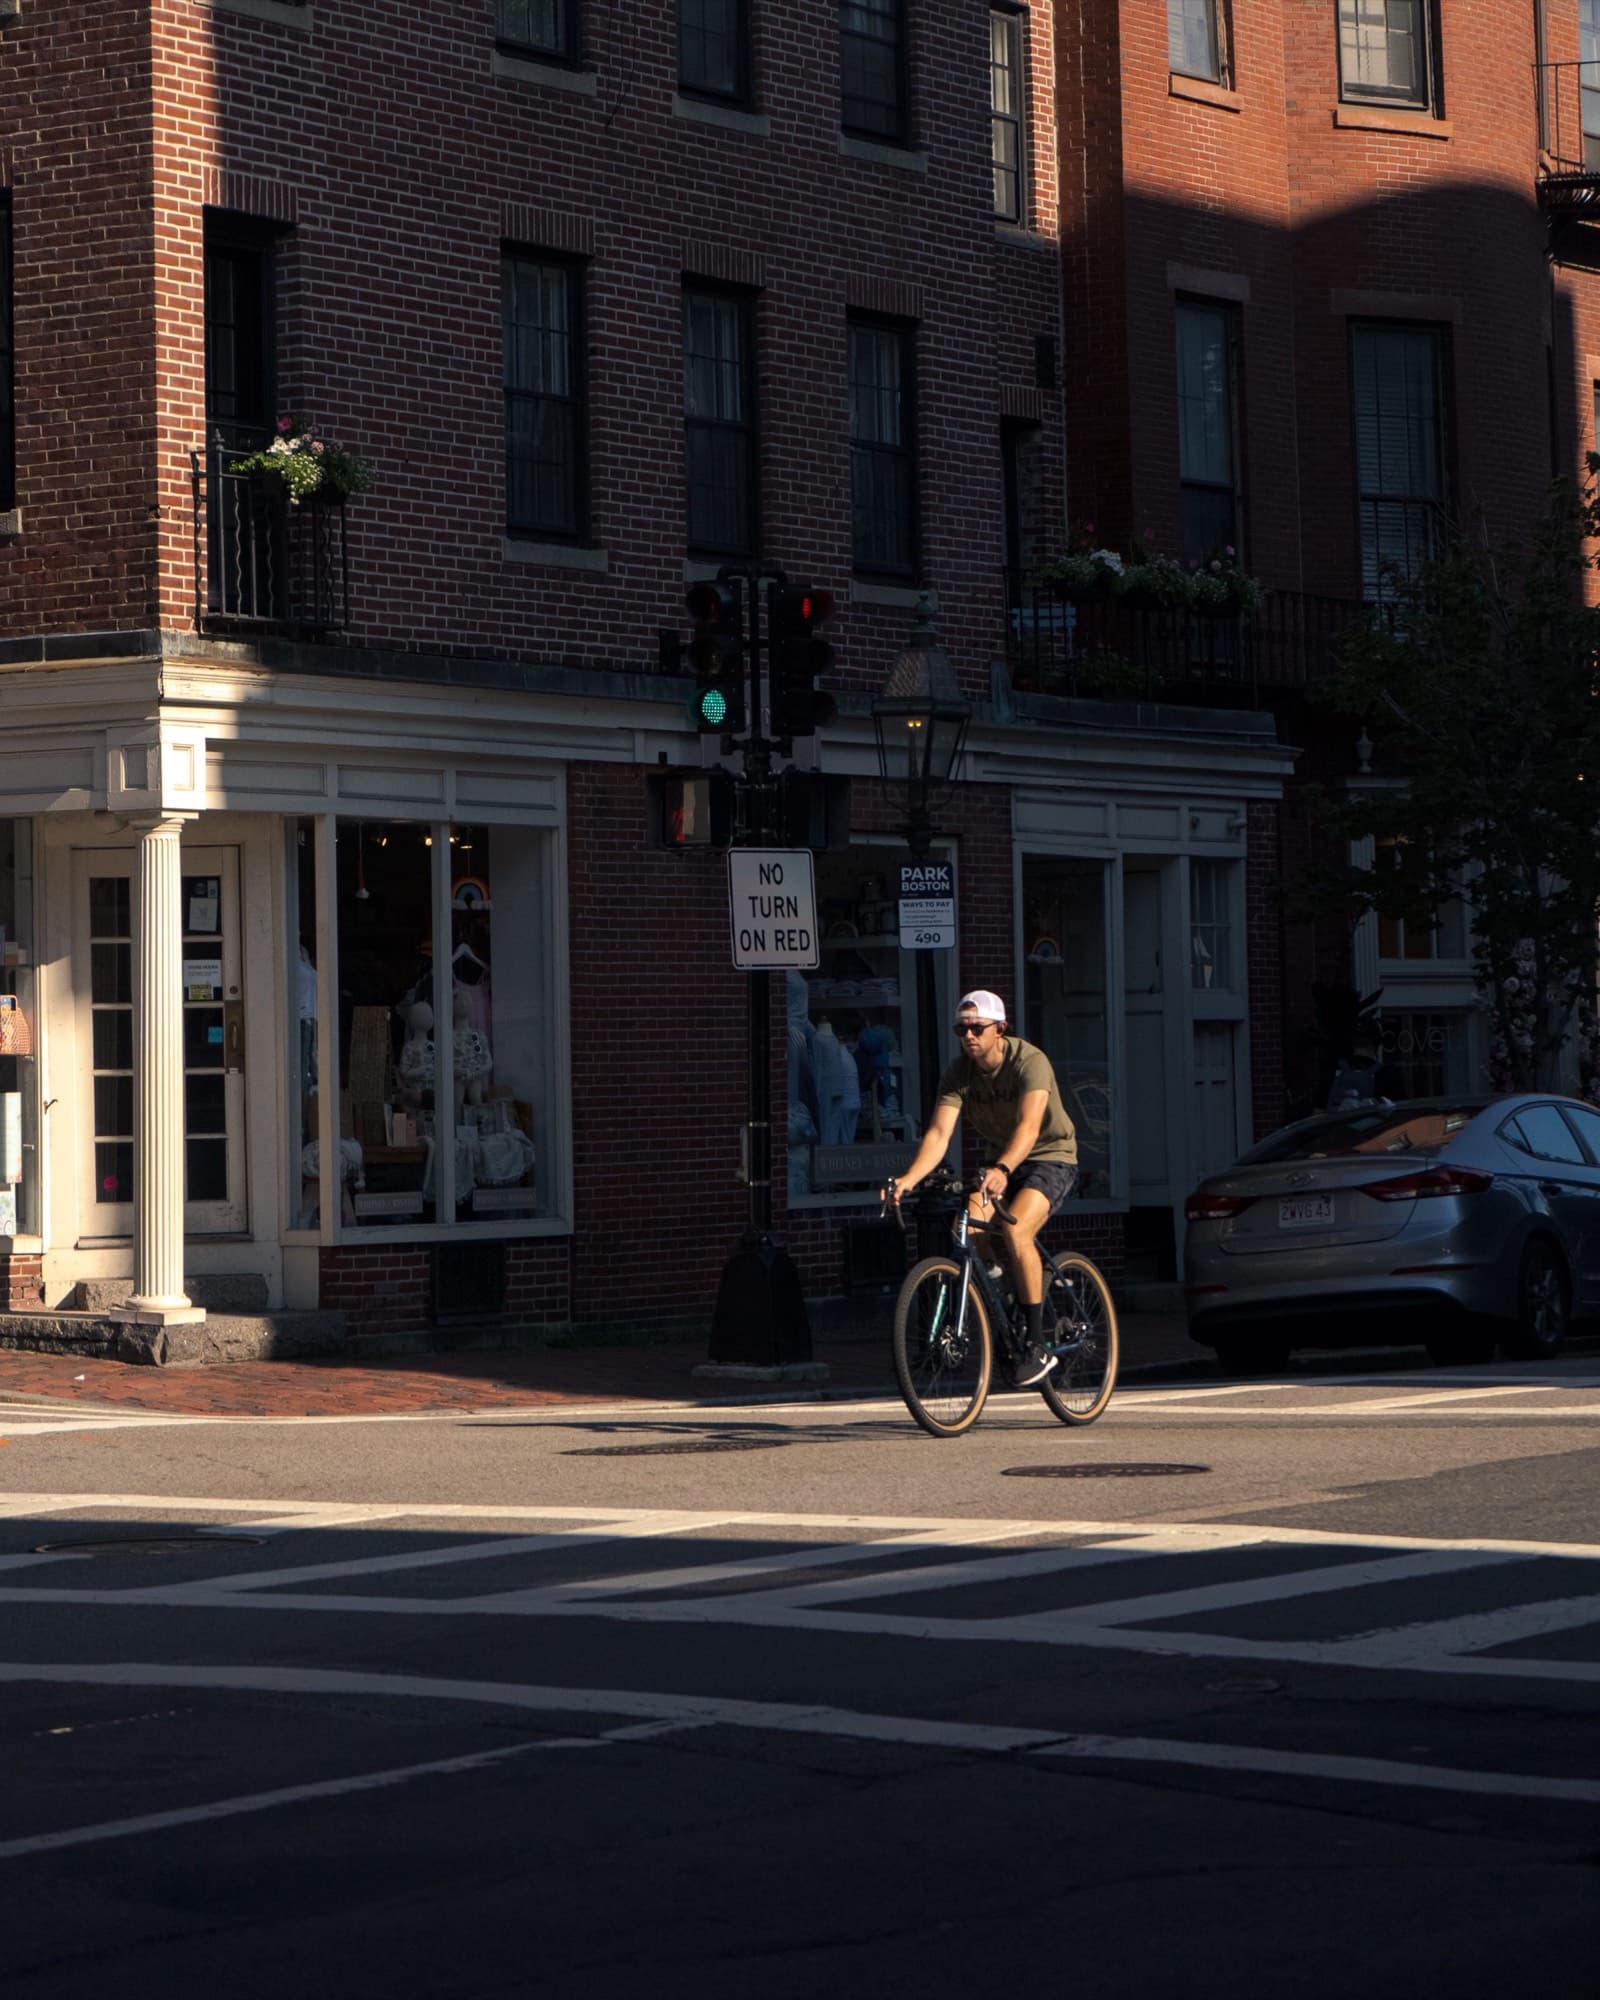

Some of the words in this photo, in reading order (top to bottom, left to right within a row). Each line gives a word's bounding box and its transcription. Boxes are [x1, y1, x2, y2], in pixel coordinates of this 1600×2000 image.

[759, 863, 784, 885] NO
[900, 866, 950, 881] PARK
[900, 881, 950, 892] BOSTON
[748, 895, 799, 918] TURN
[740, 929, 766, 952] ON
[774, 929, 811, 952] RED
[914, 932, 941, 944] 490
